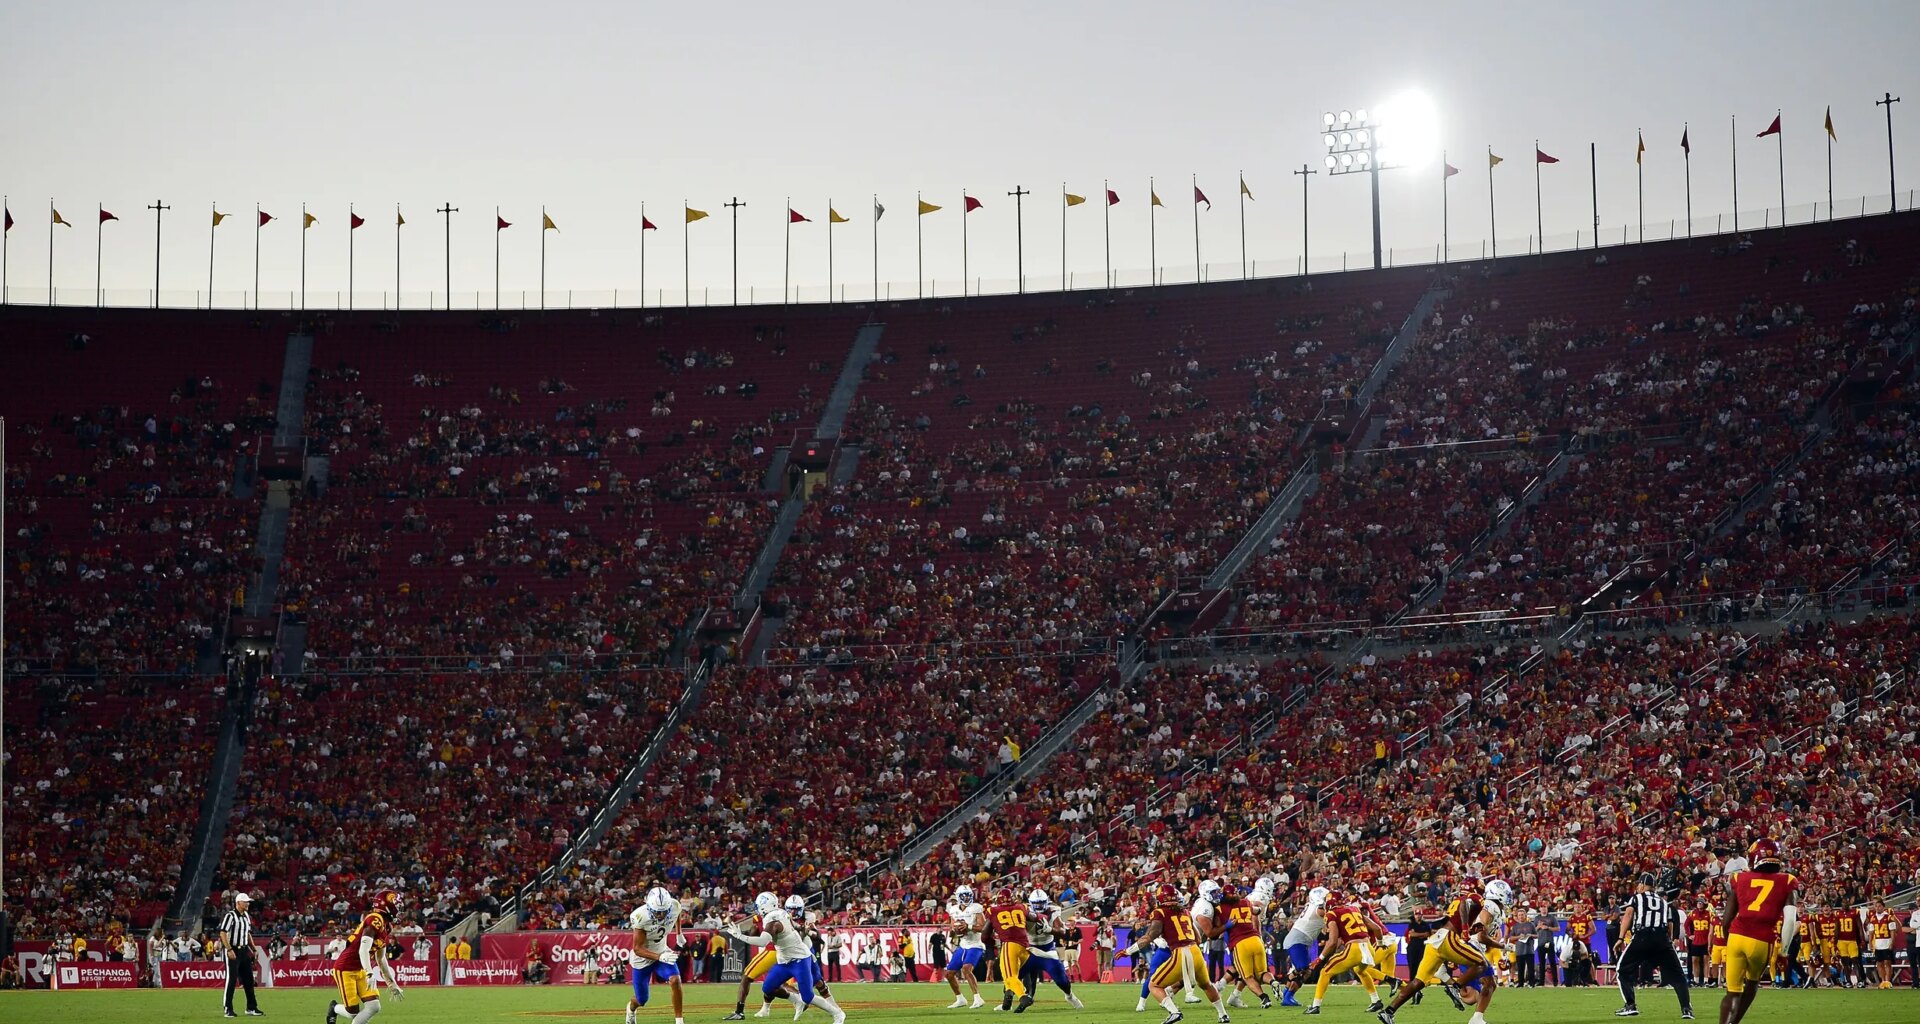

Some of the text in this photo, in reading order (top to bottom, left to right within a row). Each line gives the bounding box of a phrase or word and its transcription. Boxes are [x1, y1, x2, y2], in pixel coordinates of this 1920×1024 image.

[1634, 567, 1641, 575] 19
[1747, 879, 1775, 912] 7
[371, 917, 382, 930] 22
[997, 909, 1026, 930] 90
[1340, 911, 1368, 936] 25
[1839, 918, 1853, 932] 10
[653, 927, 666, 943] 3
[1171, 915, 1195, 941] 13
[289, 968, 323, 977] Invesco
[396, 965, 427, 974] United
[397, 974, 431, 982] Rentals
